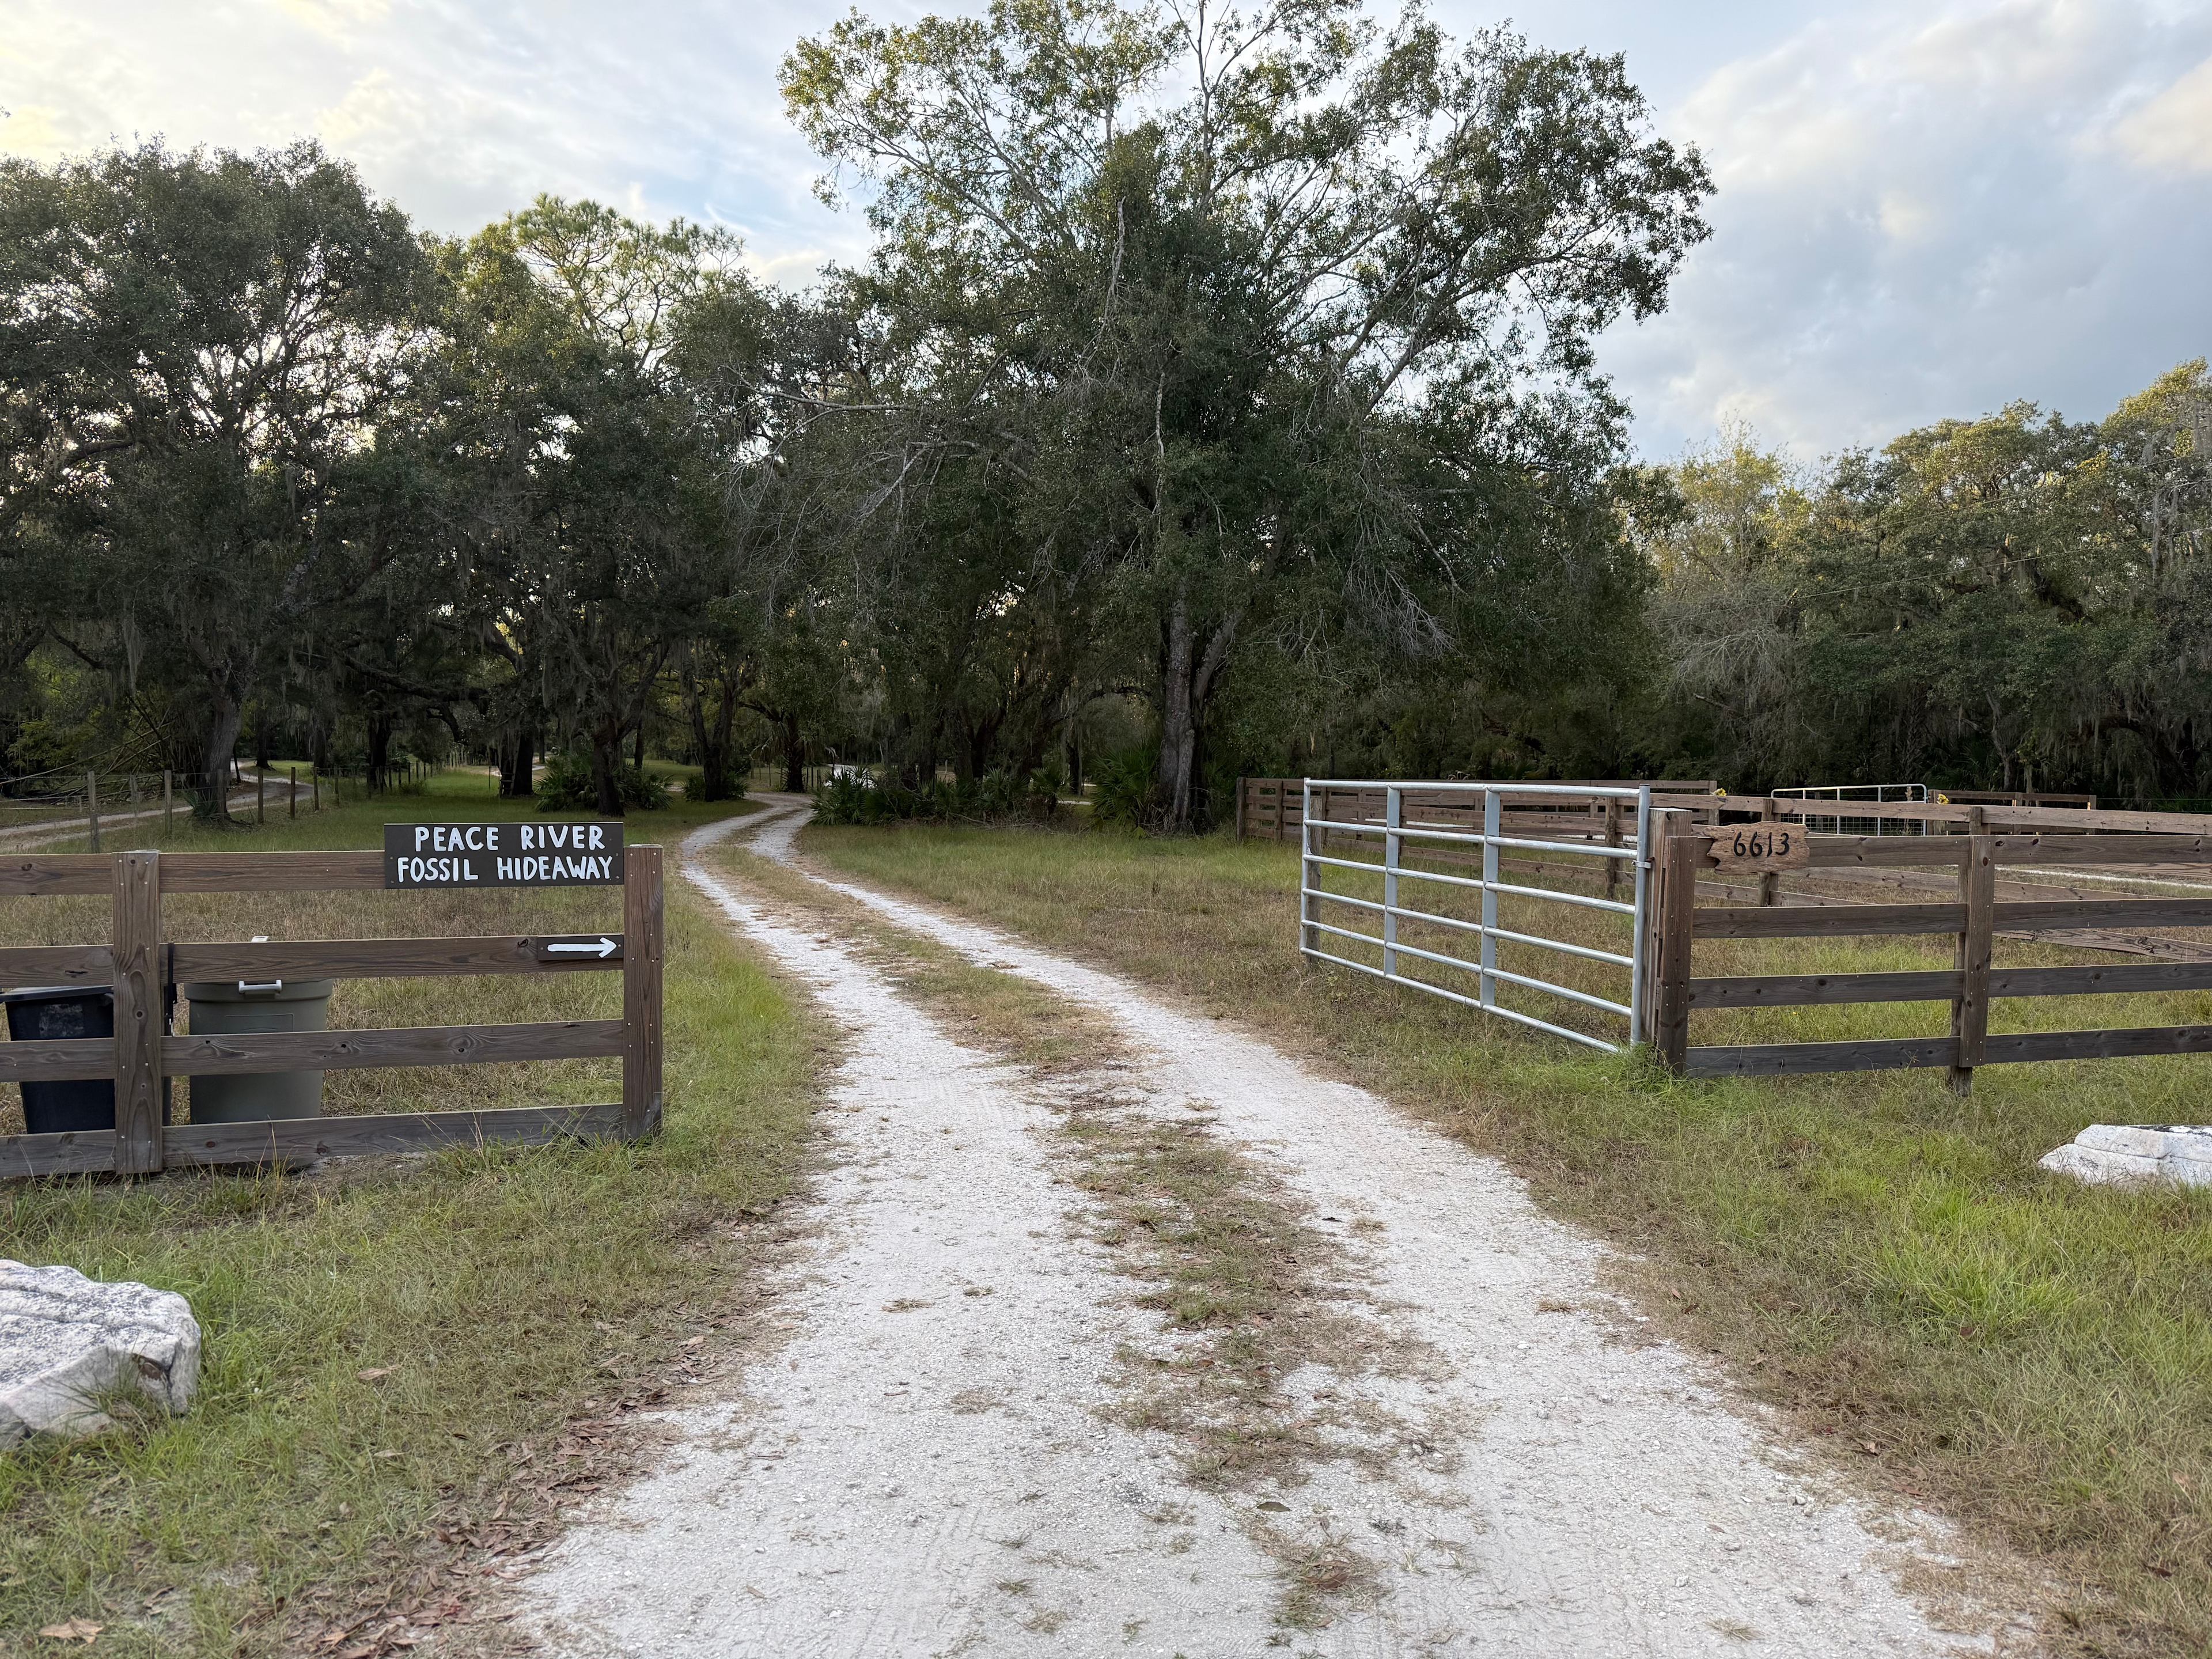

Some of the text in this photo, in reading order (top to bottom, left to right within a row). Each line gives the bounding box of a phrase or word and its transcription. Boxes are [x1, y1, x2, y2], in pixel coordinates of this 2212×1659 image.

[415, 825, 605, 852] PEACE RIVER
[1733, 831, 1790, 858] 6613
[397, 855, 613, 882] FOSSIL HIDEAWAY
